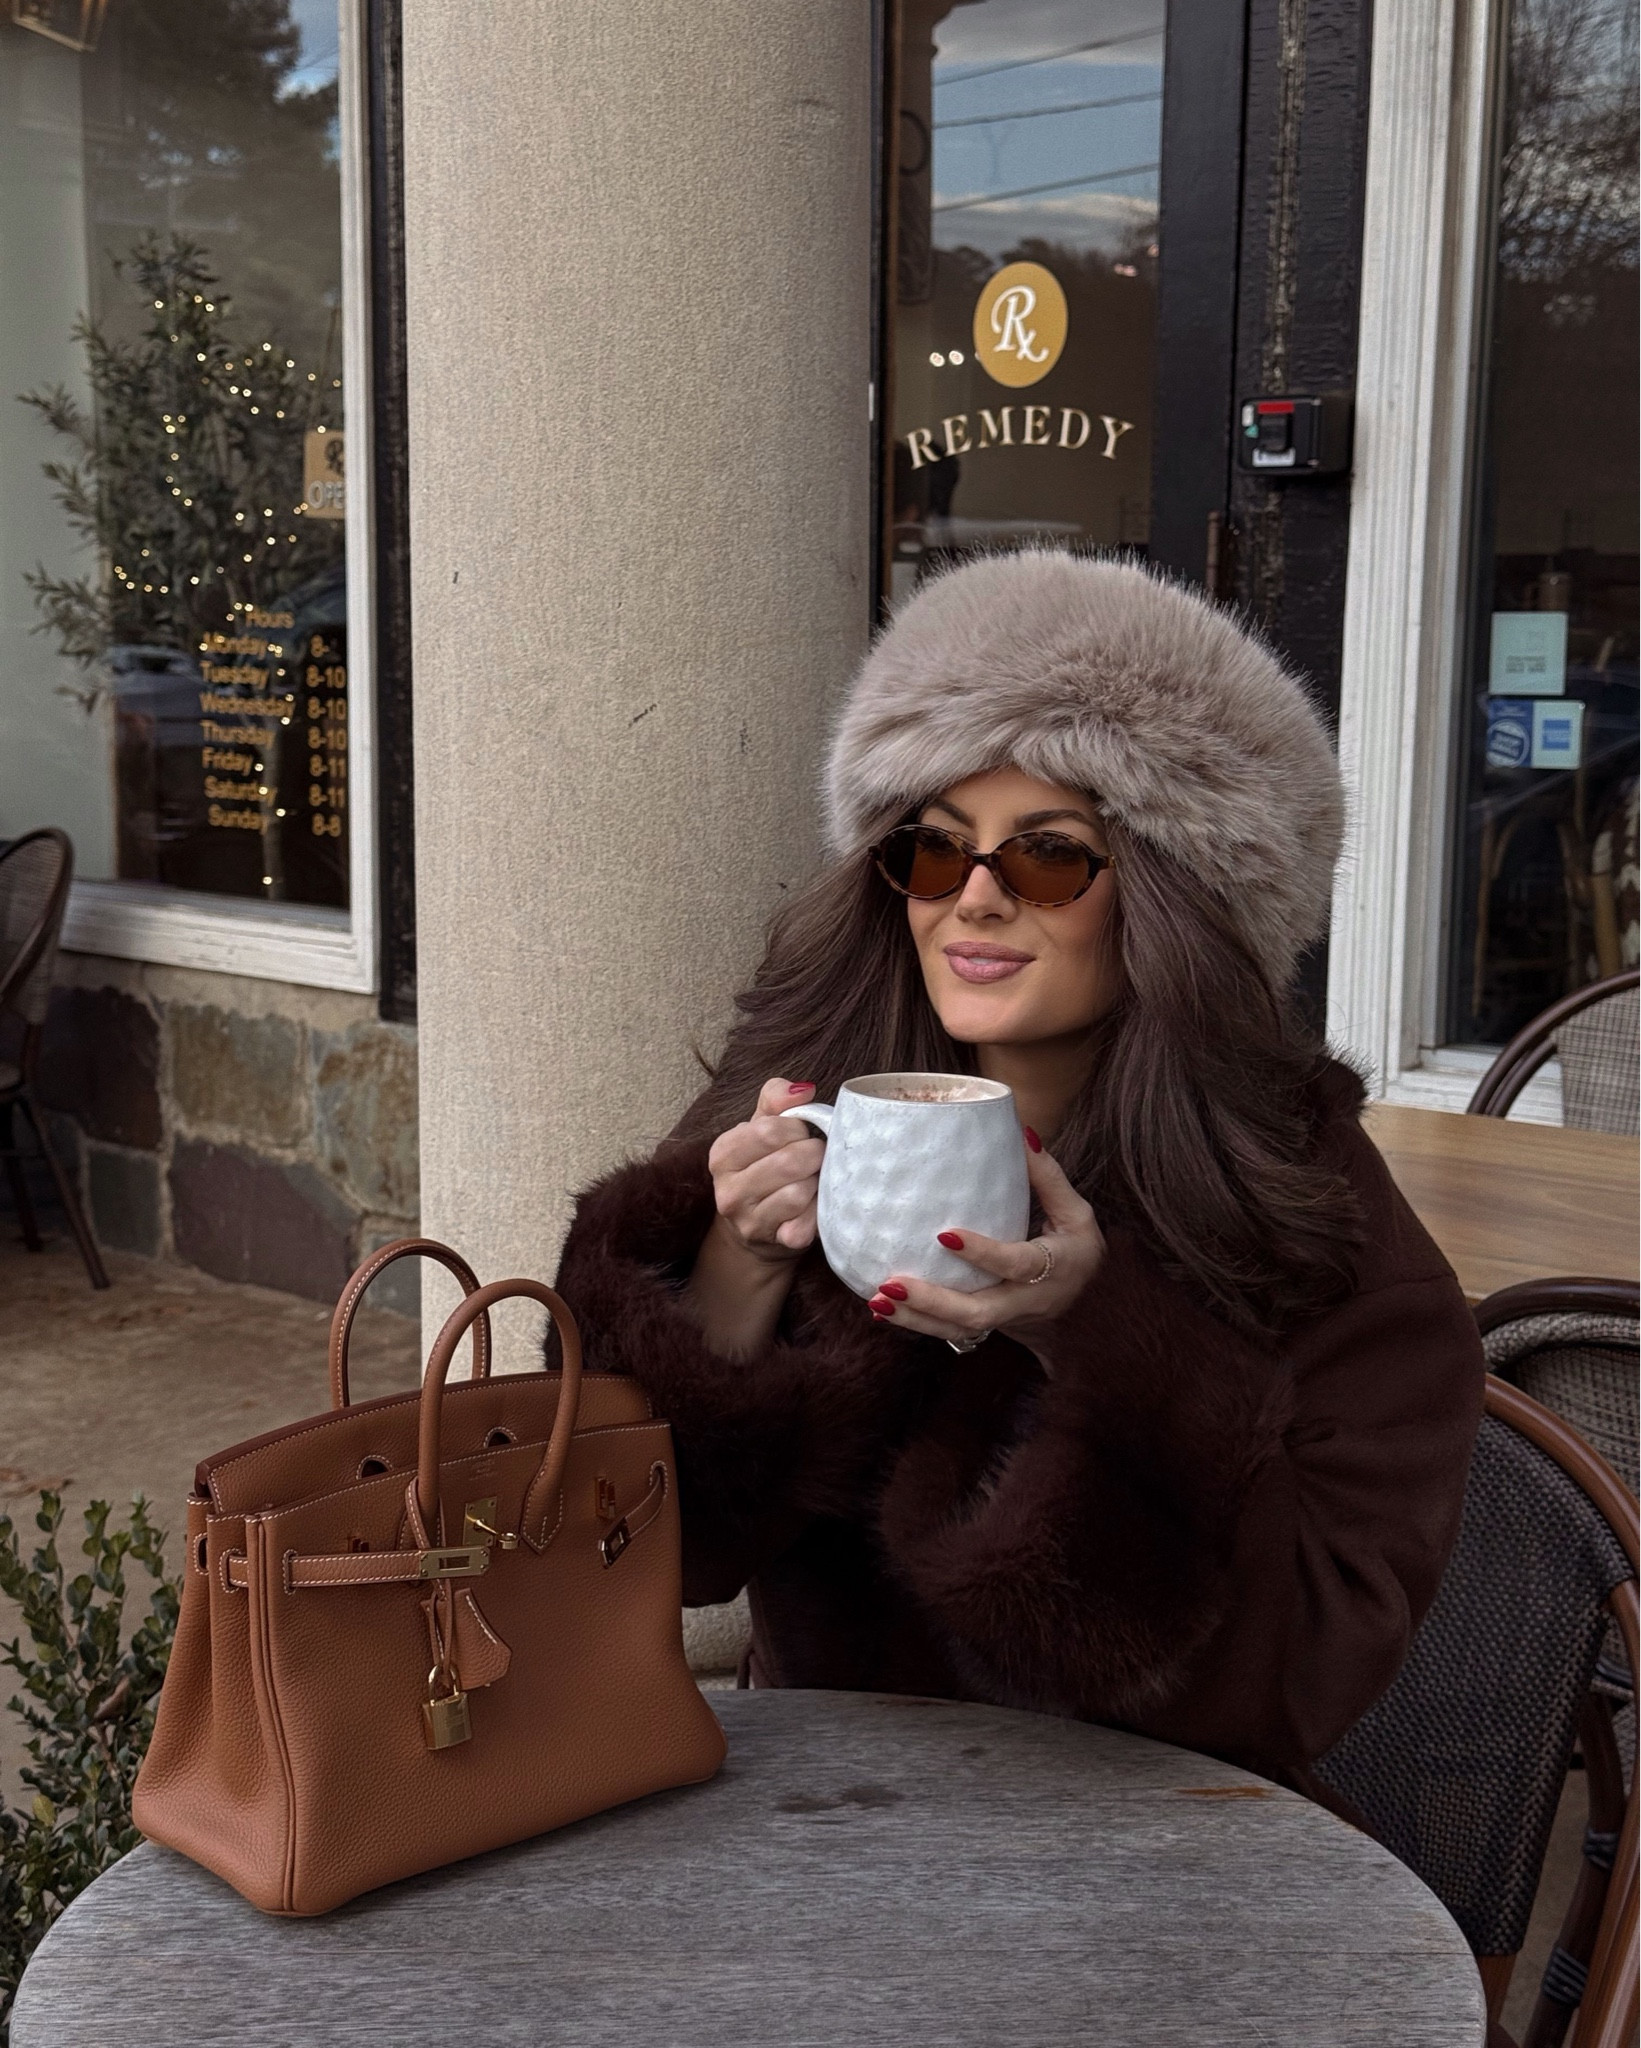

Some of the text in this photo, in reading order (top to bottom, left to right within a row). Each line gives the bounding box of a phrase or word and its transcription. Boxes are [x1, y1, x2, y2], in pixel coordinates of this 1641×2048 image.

[906, 405, 1135, 471] REMEDY
[308, 480, 344, 509] OPE
[246, 609, 294, 628] Hours
[200, 662, 346, 689] Tuesday 8-10
[200, 694, 346, 720] Wednesday 8-10
[200, 721, 347, 750] Thursday 8-10
[202, 747, 346, 778] Friday 8-11
[309, 784, 346, 808] 8-11
[208, 803, 269, 835] Sunday
